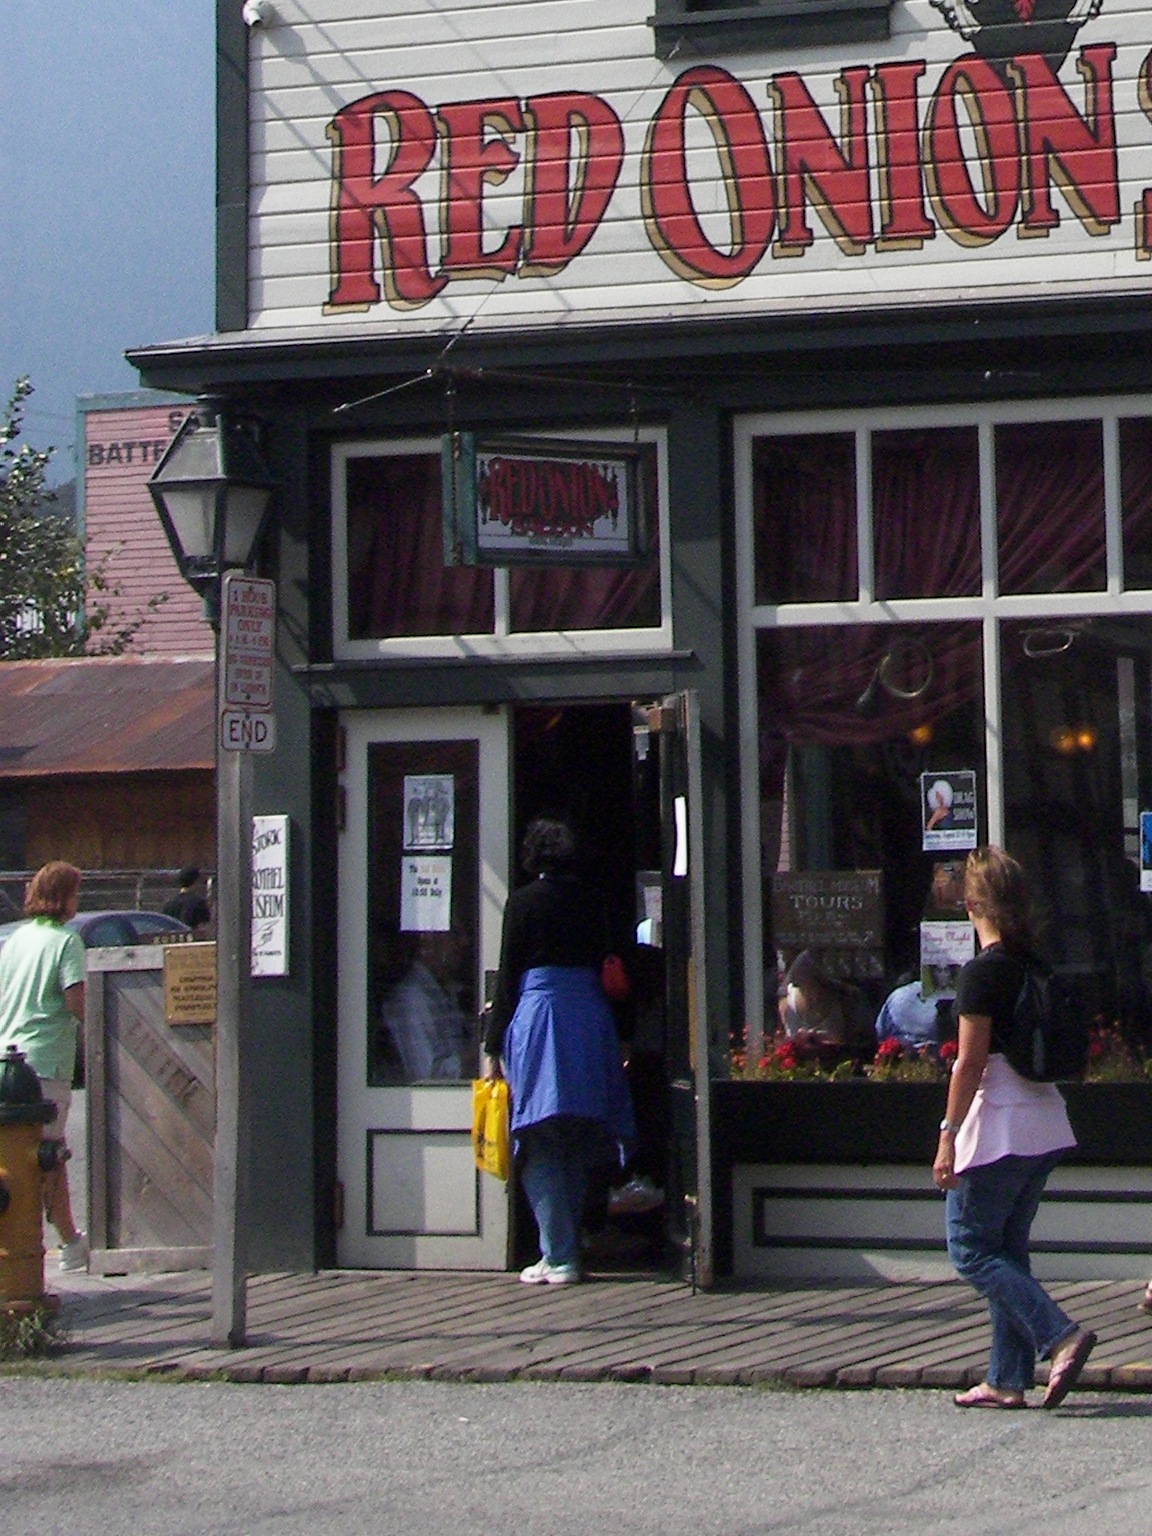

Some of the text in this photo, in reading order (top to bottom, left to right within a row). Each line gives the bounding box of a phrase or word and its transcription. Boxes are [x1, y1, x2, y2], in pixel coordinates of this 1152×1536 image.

[322, 88, 627, 316] RED
[639, 42, 1121, 291] ONION
[88, 440, 168, 466] BATTE
[229, 719, 268, 743] END
[252, 828, 283, 856] STORIC
[790, 895, 863, 911] TOURS
